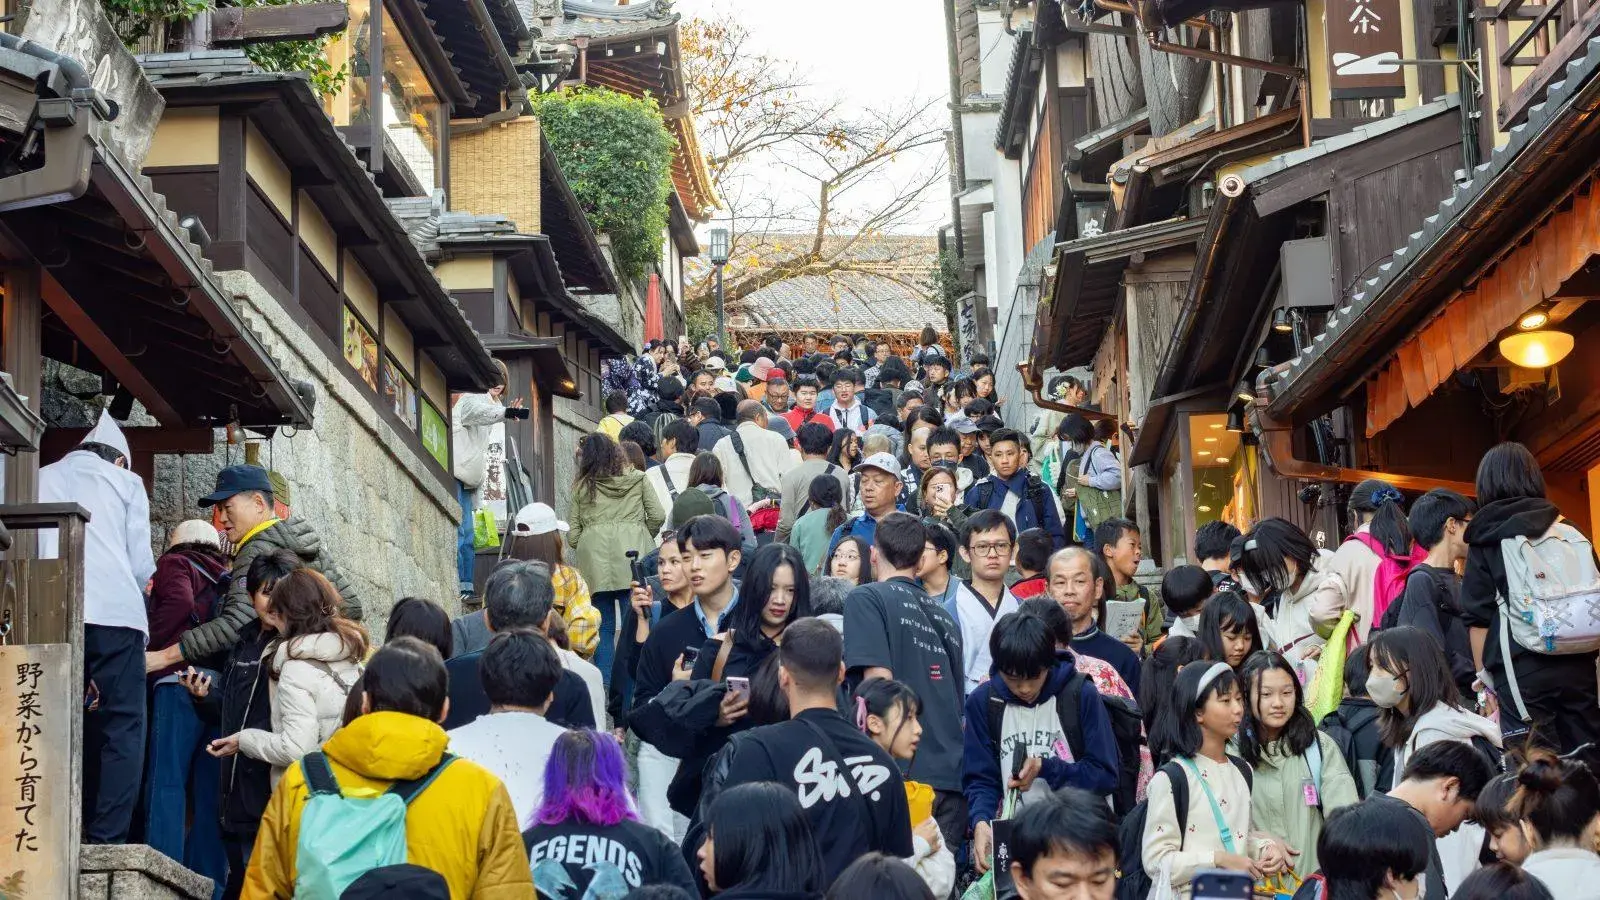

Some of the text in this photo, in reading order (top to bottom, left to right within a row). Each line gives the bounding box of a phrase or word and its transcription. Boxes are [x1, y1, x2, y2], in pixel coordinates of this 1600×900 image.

[15, 662, 43, 852] 野菜から育てた
[530, 834, 642, 888] EGENDS
